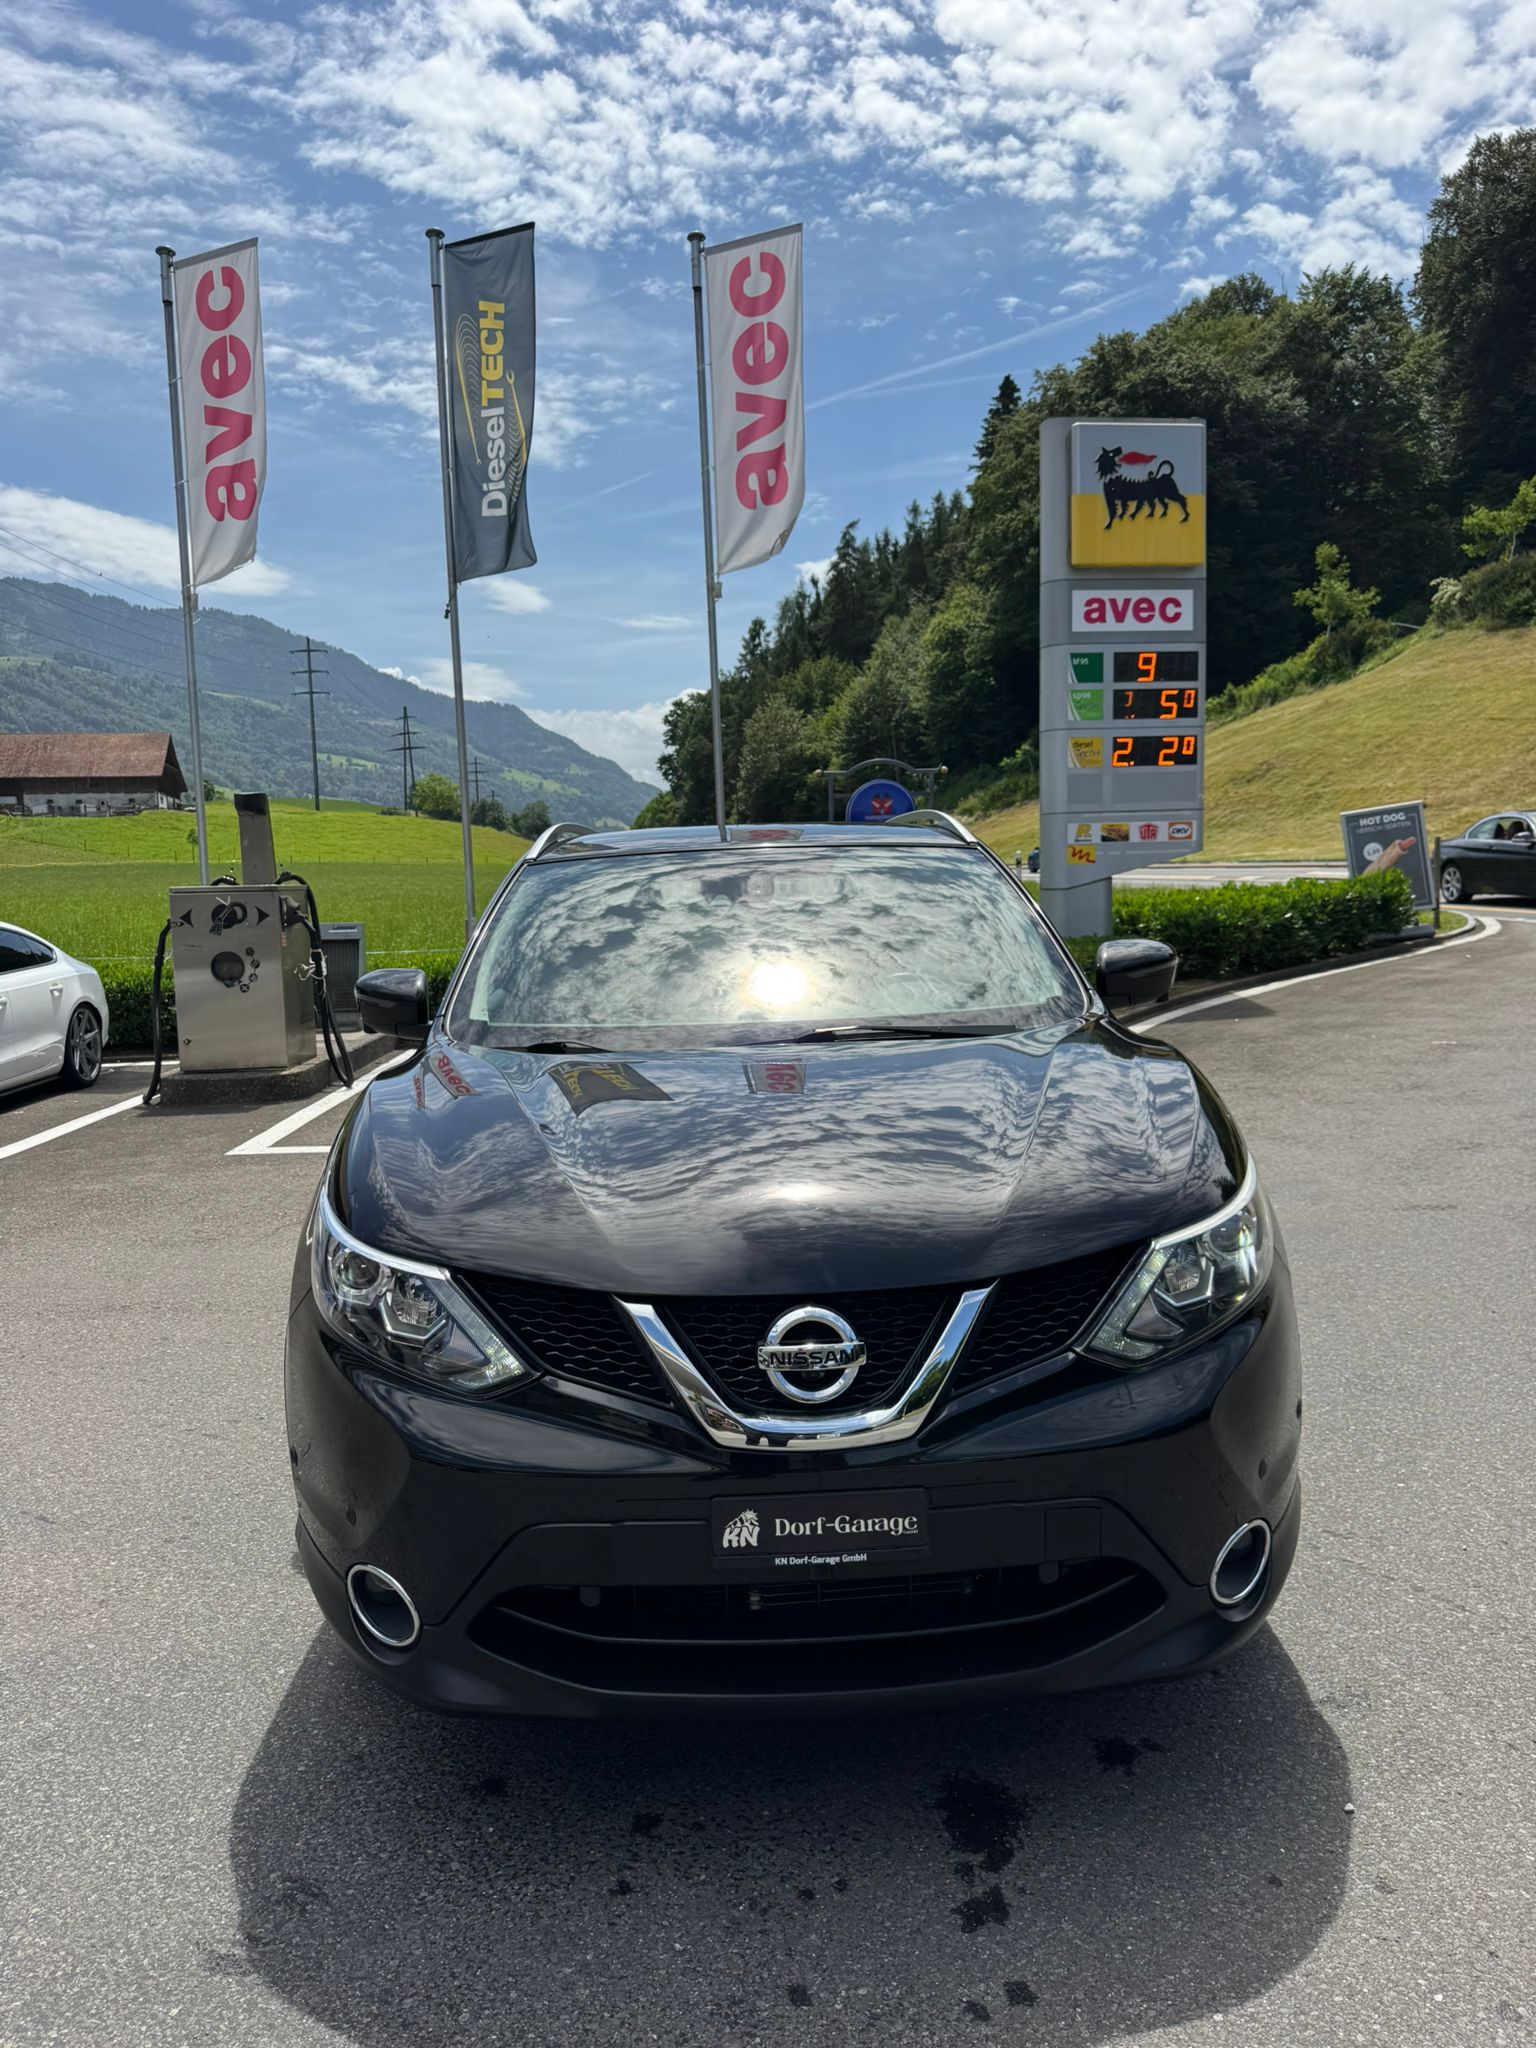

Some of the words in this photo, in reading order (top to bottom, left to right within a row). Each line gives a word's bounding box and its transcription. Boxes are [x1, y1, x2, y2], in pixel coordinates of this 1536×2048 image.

[729, 252, 789, 511] avec
[195, 265, 257, 522] avec
[1083, 597, 1182, 624] avec
[1359, 815, 1381, 826] HOT
[1383, 812, 1406, 822] DOG
[770, 1350, 857, 1366] NISSAN
[722, 1525, 761, 1549] KN
[774, 1514, 918, 1537] Dorf-Garage
[775, 1557, 788, 1566] KN
[789, 1555, 841, 1566] Dorf-Garage
[842, 1553, 867, 1563] GmbH
